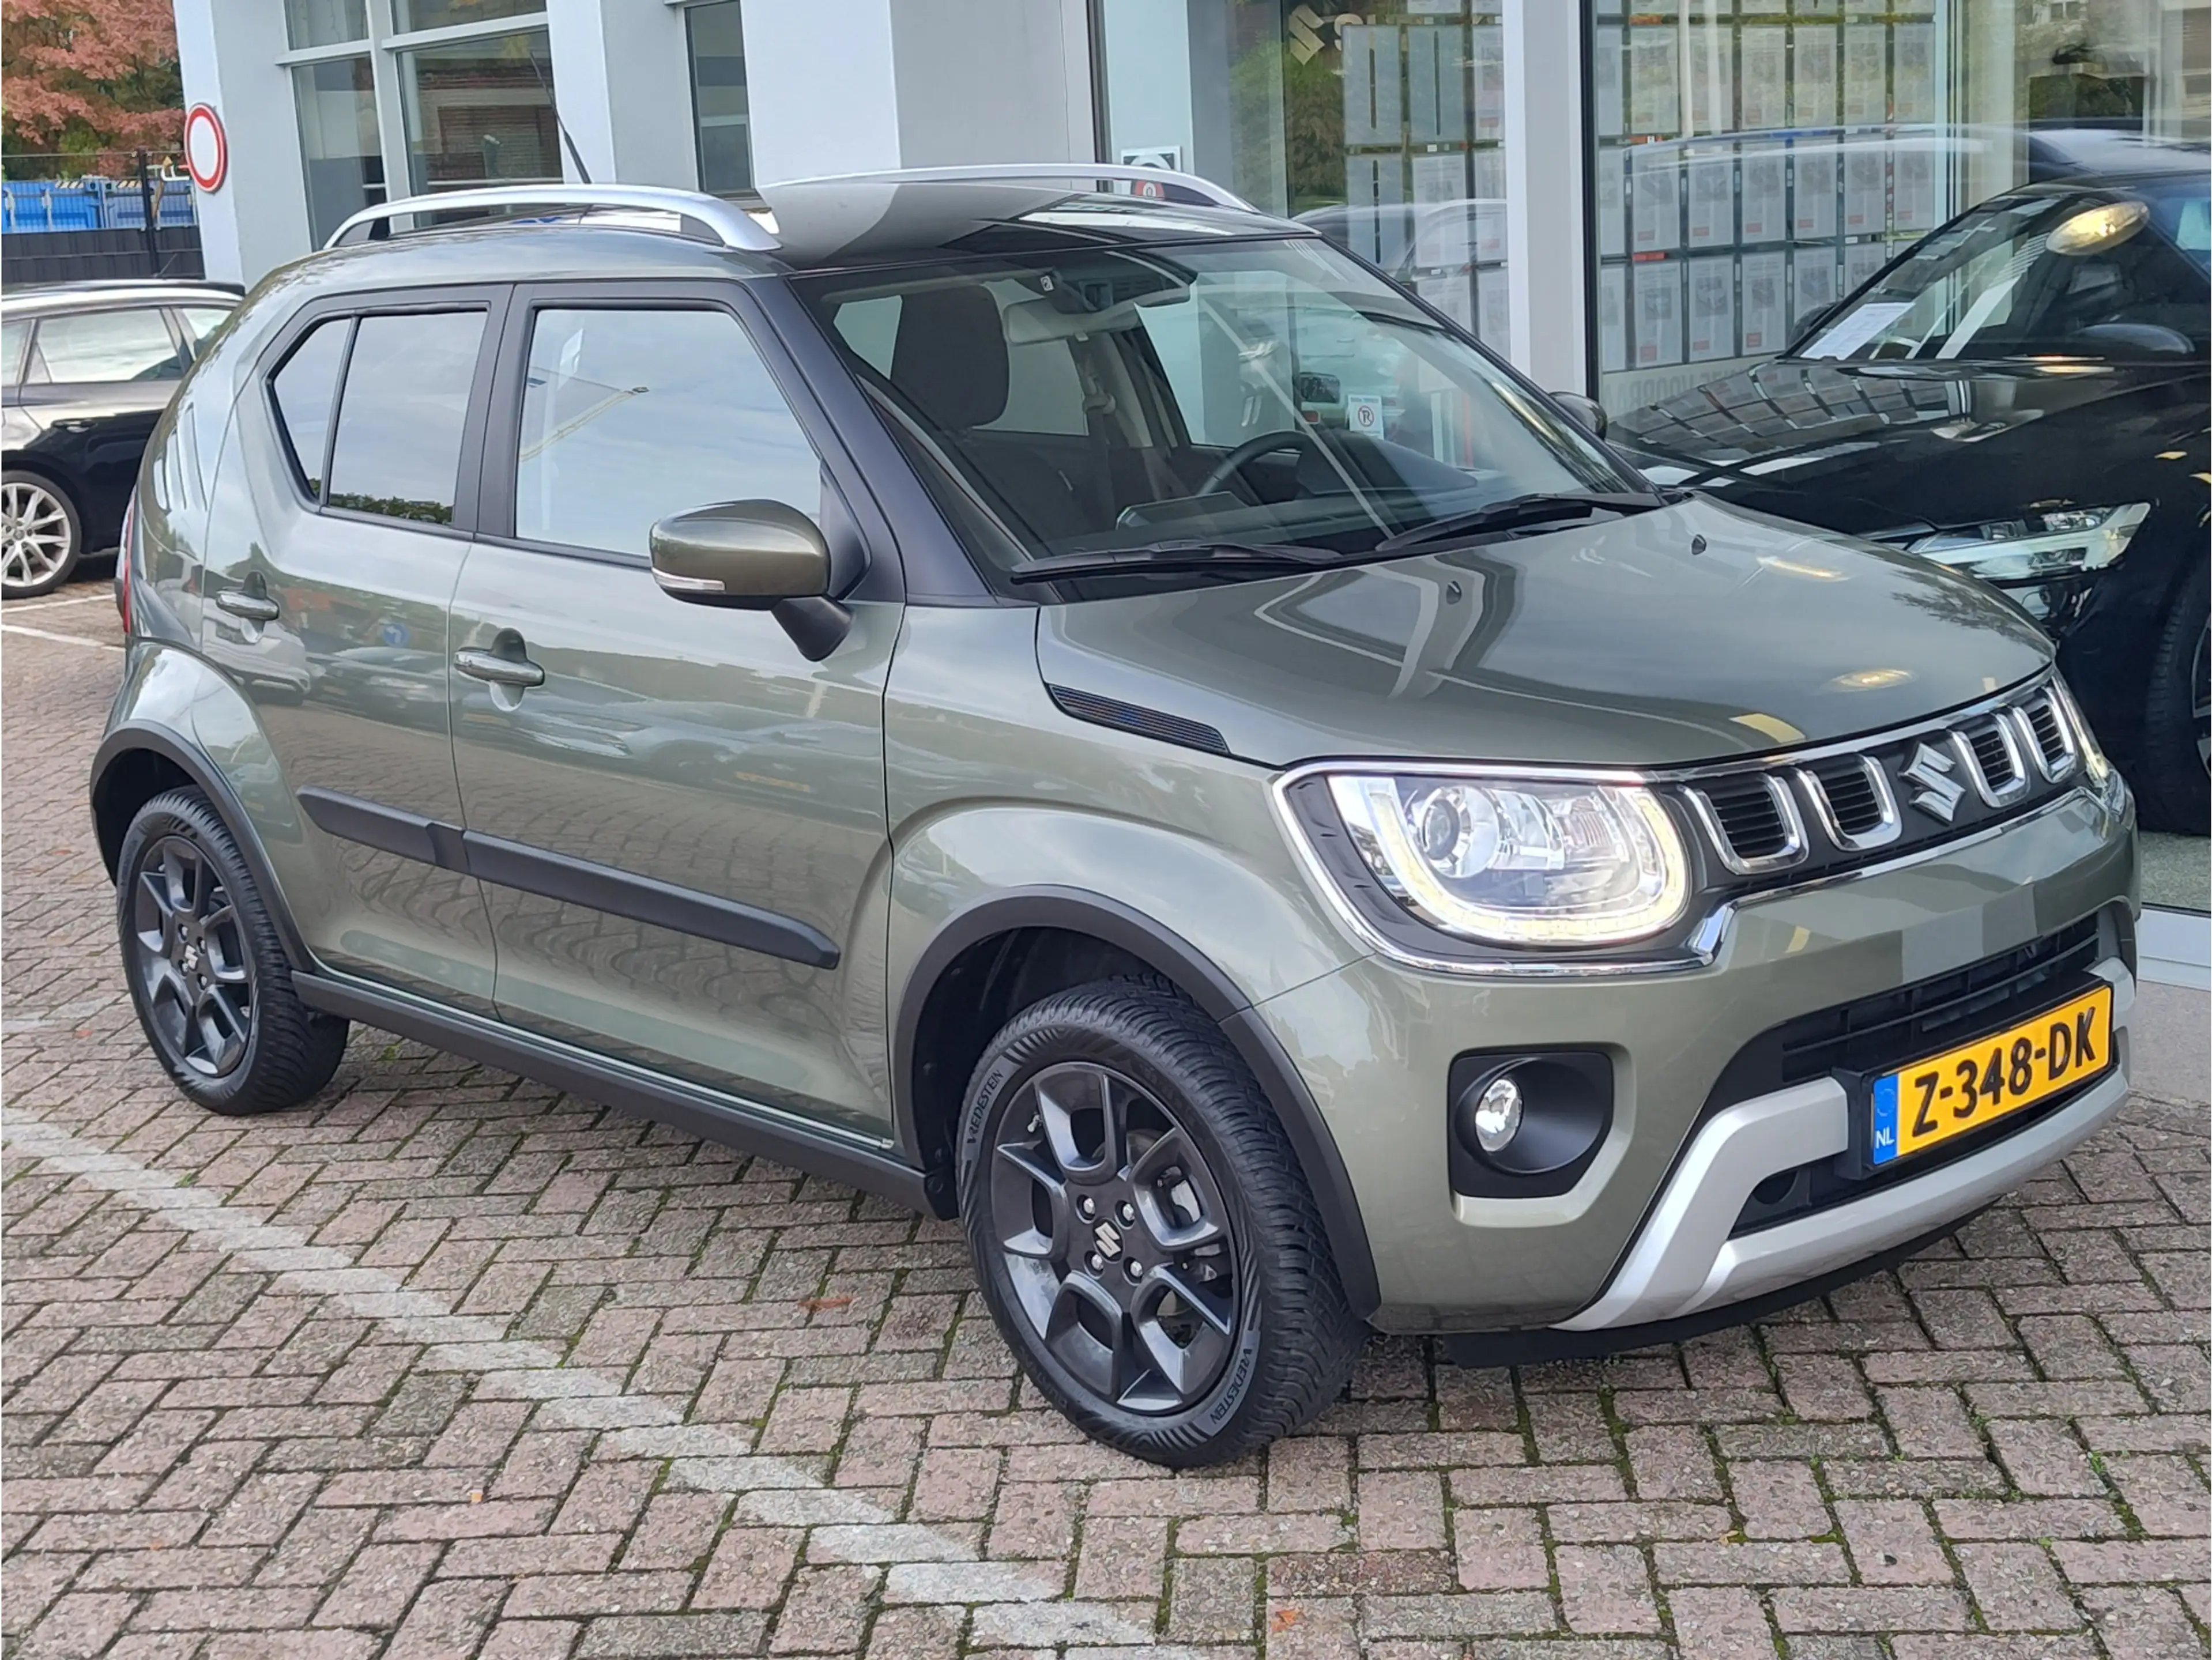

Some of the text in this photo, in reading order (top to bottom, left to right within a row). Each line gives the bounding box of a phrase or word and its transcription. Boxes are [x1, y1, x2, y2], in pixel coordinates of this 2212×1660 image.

[967, 1070, 1004, 1144] VREDESTEIN
[1912, 1006, 2096, 1137] Z-348-DK
[1875, 1126, 1895, 1149] NL
[1210, 1349, 1252, 1424] VREDESTEIN
